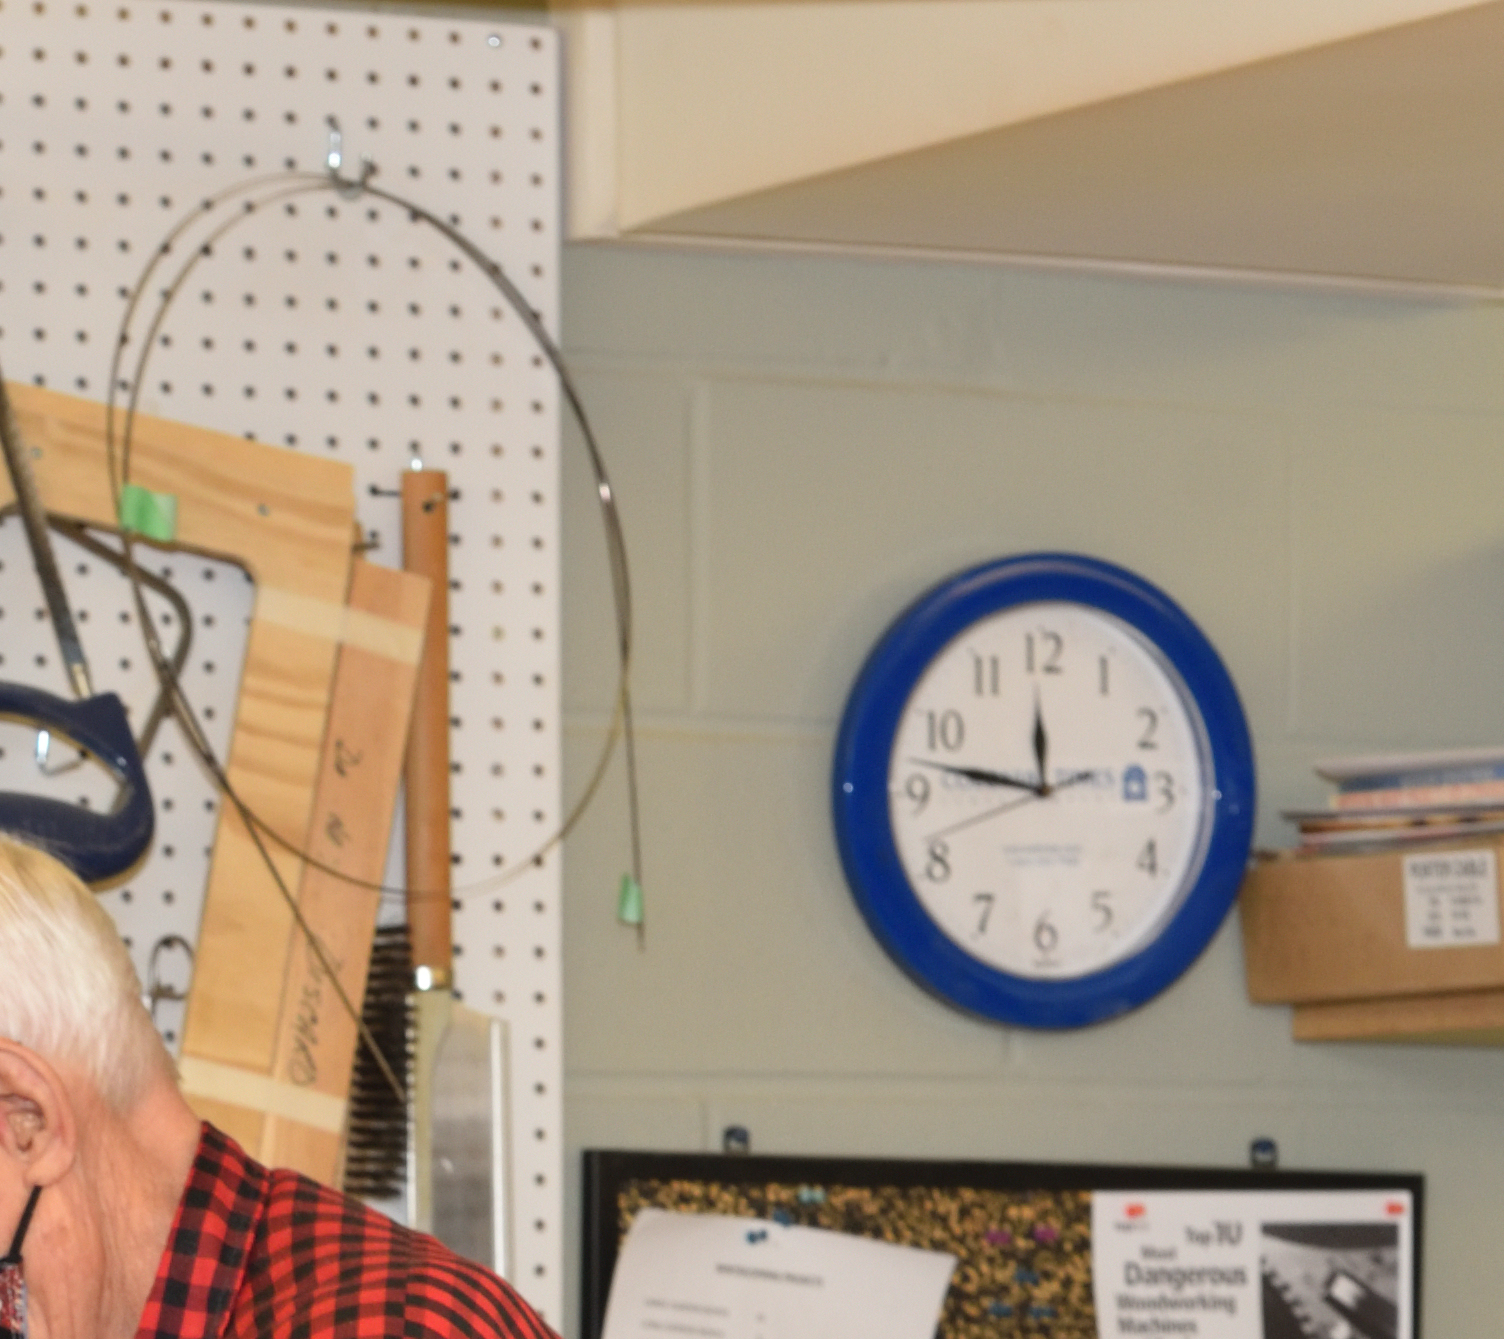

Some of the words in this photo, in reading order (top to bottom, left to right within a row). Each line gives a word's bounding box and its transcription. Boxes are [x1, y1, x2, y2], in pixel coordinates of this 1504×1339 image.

[1024, 632, 1064, 675] 12
[973, 656, 1000, 697] 11
[1098, 656, 1110, 696] 1
[925, 708, 965, 752] 10
[1136, 708, 1161, 751] 2
[906, 773, 932, 817] 9
[1153, 770, 1176, 814] 3
[926, 843, 952, 884] 8
[1136, 838, 1160, 878] 4
[973, 892, 997, 936] 7
[1033, 908, 1059, 952] 6
[1091, 890, 1115, 935] 5
[1185, 1226, 1211, 1244] Top
[1124, 1262, 1247, 1291] Dangerous
[1116, 1294, 1237, 1315] Woodworking
[1118, 1316, 1196, 1334] Machines
